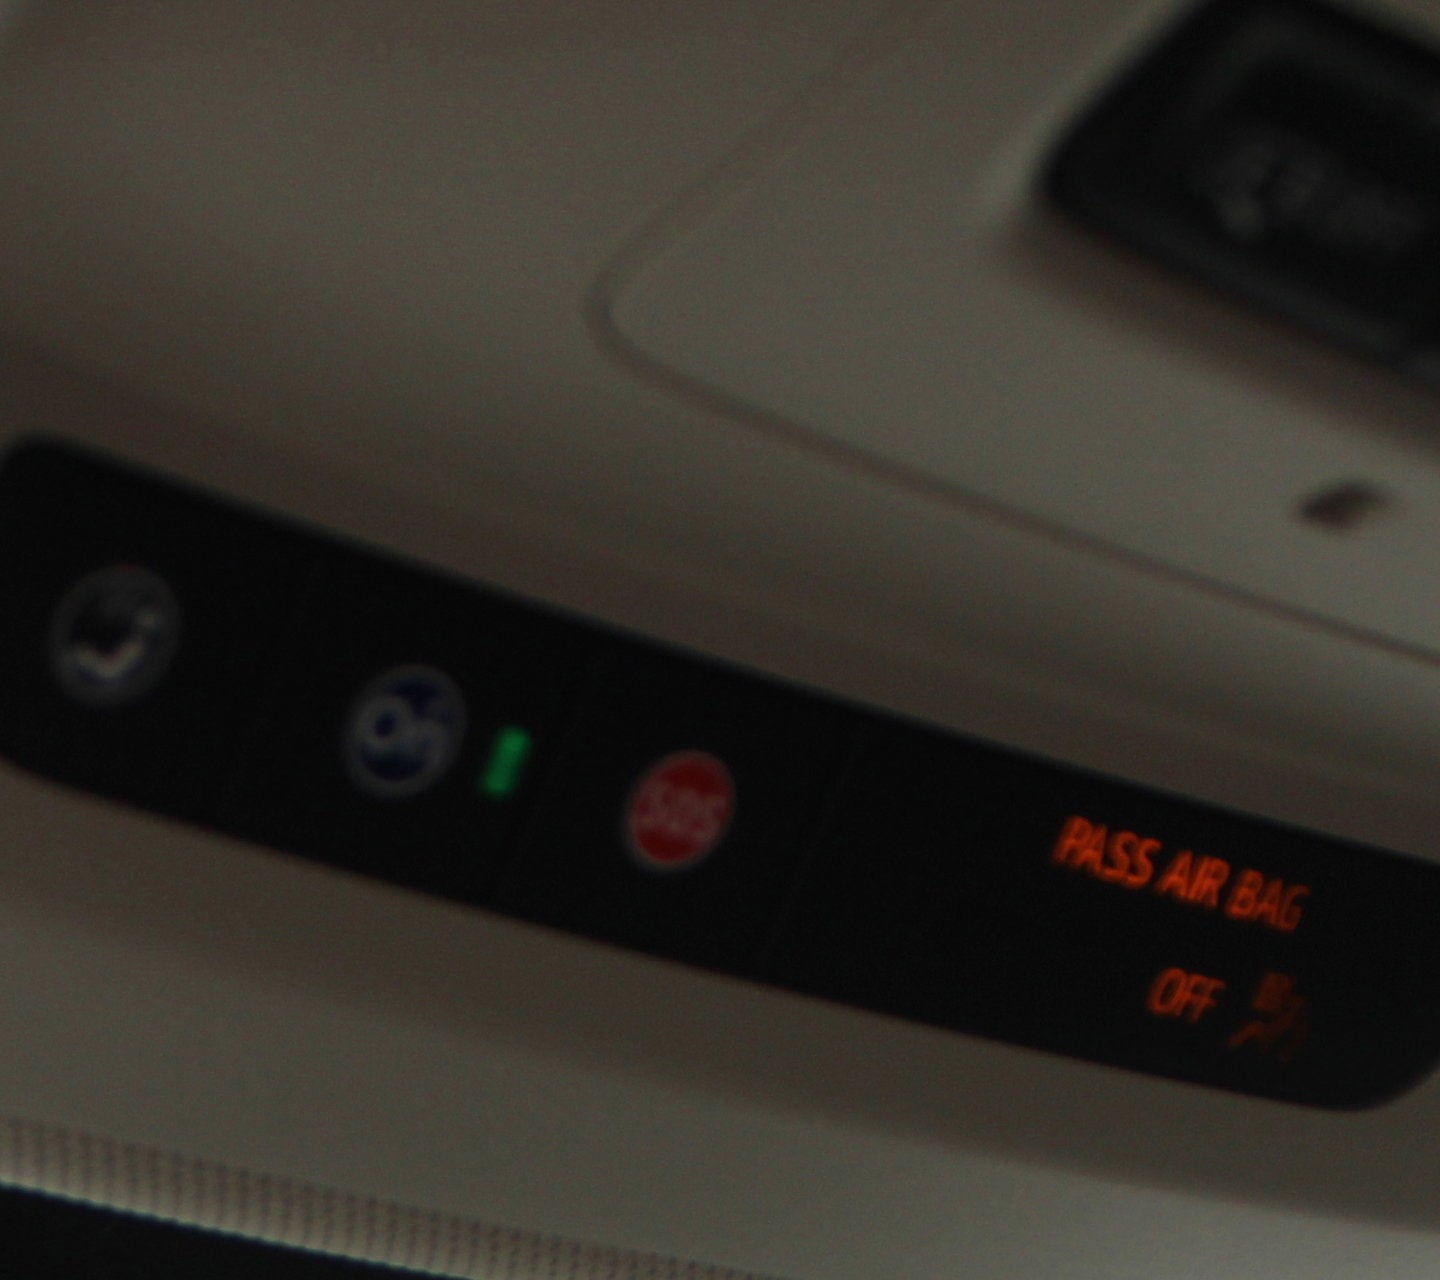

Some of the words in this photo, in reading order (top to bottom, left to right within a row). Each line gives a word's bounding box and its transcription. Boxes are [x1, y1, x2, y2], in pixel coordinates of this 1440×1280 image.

[634, 780, 728, 849] SOS
[1051, 815, 1162, 889] PASS
[1156, 849, 1231, 909] AIR
[1223, 869, 1311, 933] BAG
[1145, 966, 1226, 1022] OFF
